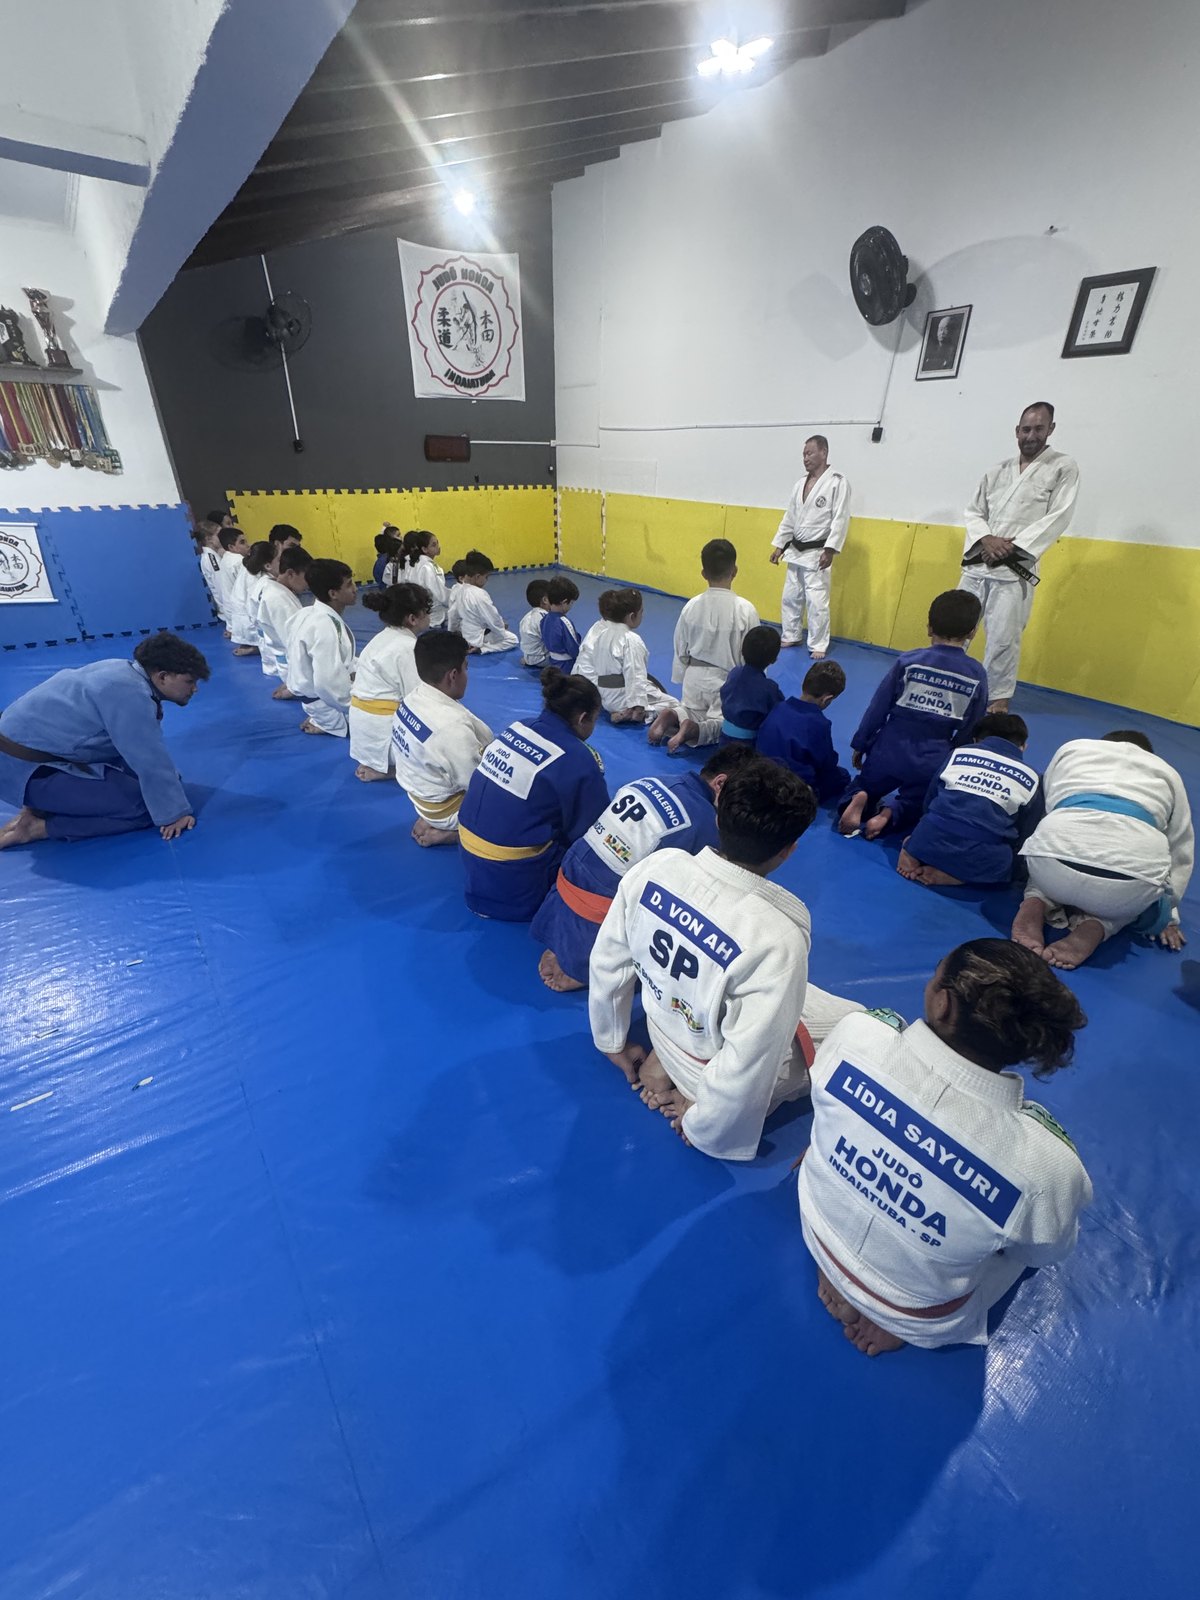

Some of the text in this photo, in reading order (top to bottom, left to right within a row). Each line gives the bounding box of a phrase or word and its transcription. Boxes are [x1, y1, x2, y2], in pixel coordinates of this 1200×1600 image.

[909, 693, 952, 712] HONDA
[407, 715, 421, 731] LUIS
[485, 750, 514, 778] HONDA
[514, 740, 544, 762] COSTA
[956, 757, 1032, 787] SAMUEL KAZUO
[958, 774, 1011, 796] HONDA
[611, 794, 647, 823] SP
[651, 790, 680, 826] SALERNO
[650, 890, 733, 962] D. VON AH
[649, 929, 699, 981] SP
[842, 1076, 1000, 1204] LÍDIA SAYURI
[871, 1147, 923, 1189] JUDÔ
[828, 1155, 906, 1229] INDAIATUBA
[920, 1231, 941, 1247] SP
[834, 1135, 947, 1237] HONDA
